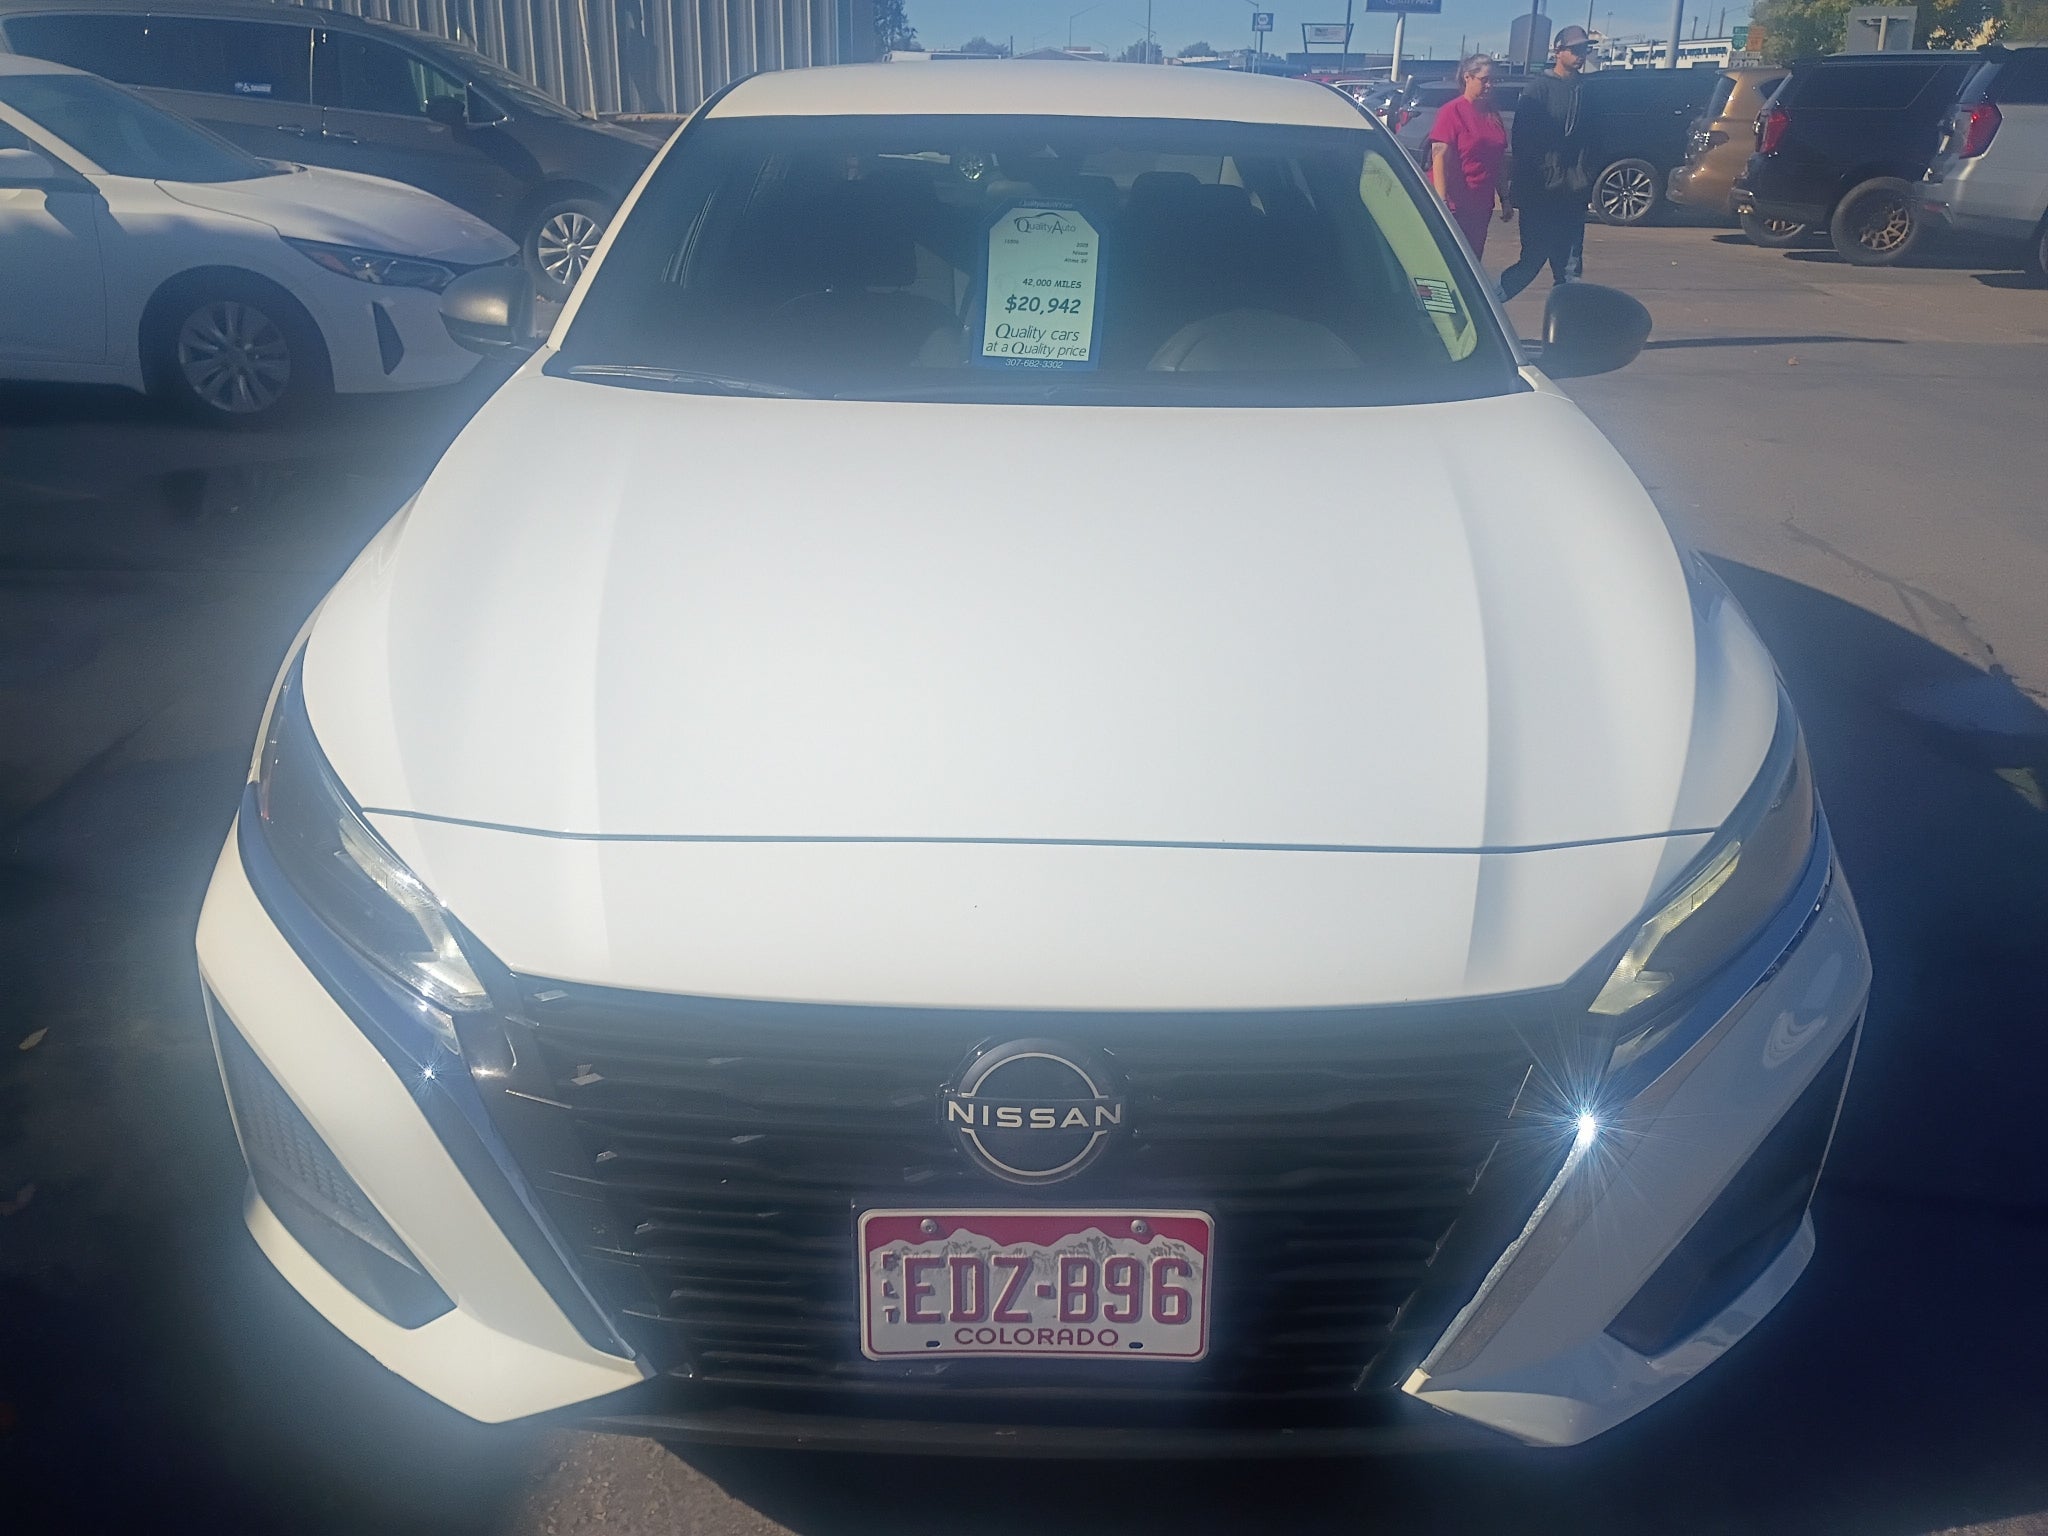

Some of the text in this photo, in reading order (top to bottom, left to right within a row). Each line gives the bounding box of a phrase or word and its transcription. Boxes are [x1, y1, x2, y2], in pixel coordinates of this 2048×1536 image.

[1022, 278, 1082, 289] 42,000 MILES
[1005, 294, 1082, 315] $20,942
[995, 323, 1080, 343] Quality cars
[985, 341, 1087, 358] at a Quality price
[948, 1100, 1121, 1129] NISSAN
[903, 1255, 1193, 1325] EDZ-B96
[954, 1327, 1119, 1347] COLORADO
